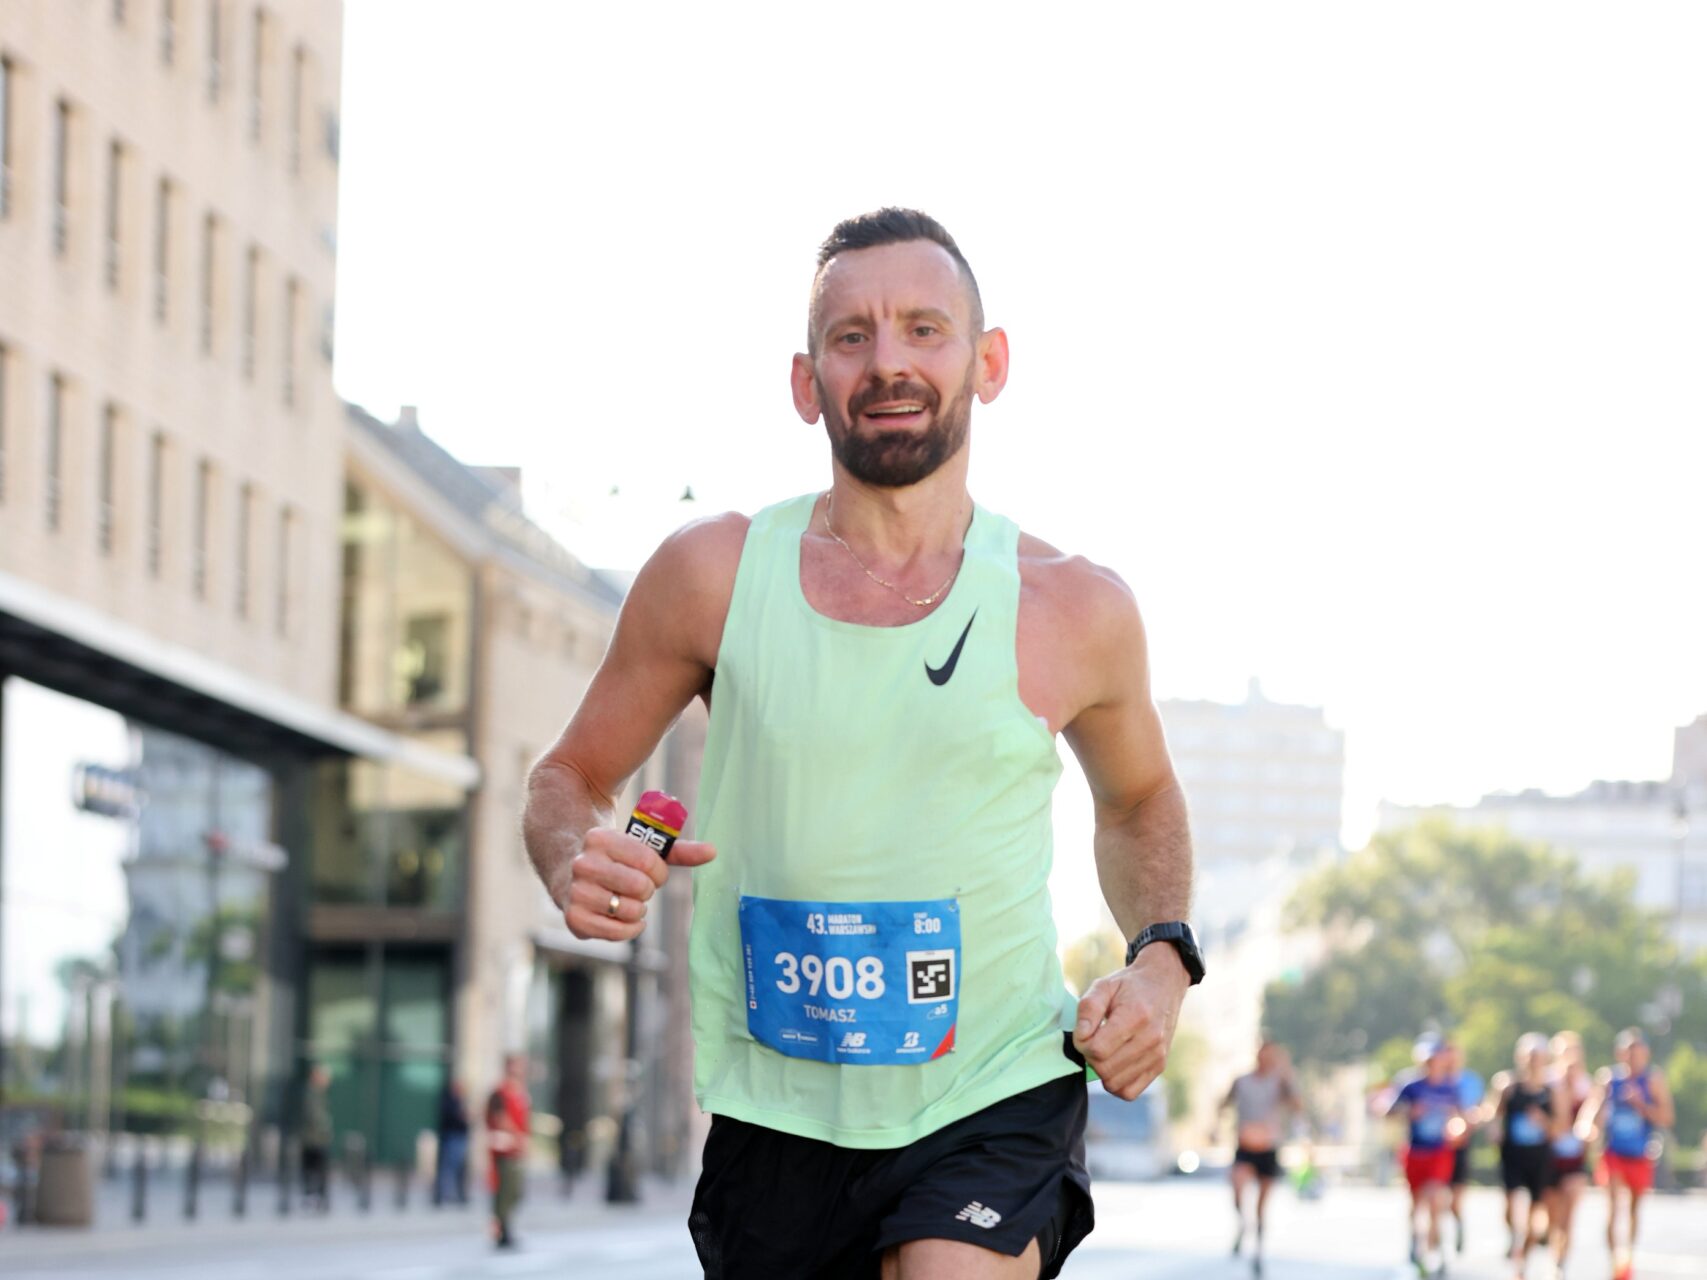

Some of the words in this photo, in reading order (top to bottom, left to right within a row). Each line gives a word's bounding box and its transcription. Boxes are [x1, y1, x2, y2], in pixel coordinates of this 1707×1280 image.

[806, 913, 828, 934] 43.
[914, 918, 941, 934] 8:00
[774, 952, 885, 1000] 3908
[803, 1004, 856, 1023] TOMASZ
